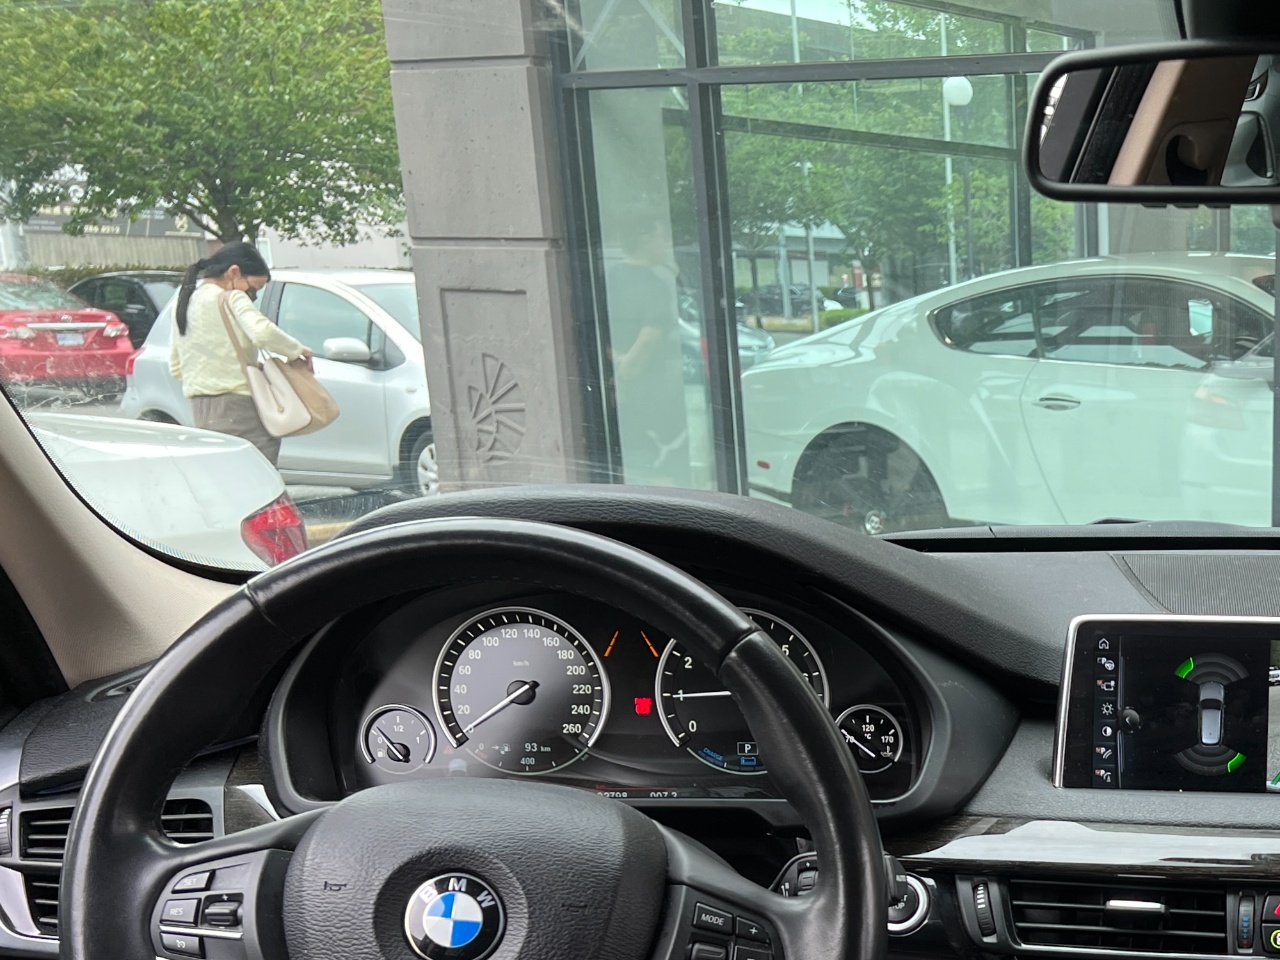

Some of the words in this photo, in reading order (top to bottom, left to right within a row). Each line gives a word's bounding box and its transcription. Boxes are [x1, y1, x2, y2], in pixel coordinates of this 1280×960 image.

[501, 628, 518, 639] 120
[523, 628, 541, 639] 140
[482, 636, 499, 647] 100
[542, 637, 560, 647] 160
[468, 649, 481, 660] 80
[557, 650, 575, 660] 180
[684, 656, 693, 669] 2
[458, 665, 471, 675] 60
[566, 665, 586, 676] 200
[454, 684, 467, 695] 40
[572, 684, 592, 695] 220
[457, 704, 470, 715] 20
[571, 704, 591, 715] 240
[562, 723, 582, 734] 260
[689, 720, 697, 732] 0
[862, 724, 875, 732] 120
[377, 736, 383, 744] 0
[881, 735, 894, 743] 170
[524, 742, 538, 752] 93
[744, 743, 752, 754] P
[520, 757, 535, 765] 400
[184, 878, 197, 886] SET
[419, 877, 496, 908] BMW
[169, 908, 183, 916] RES
[700, 913, 725, 926] MODE
